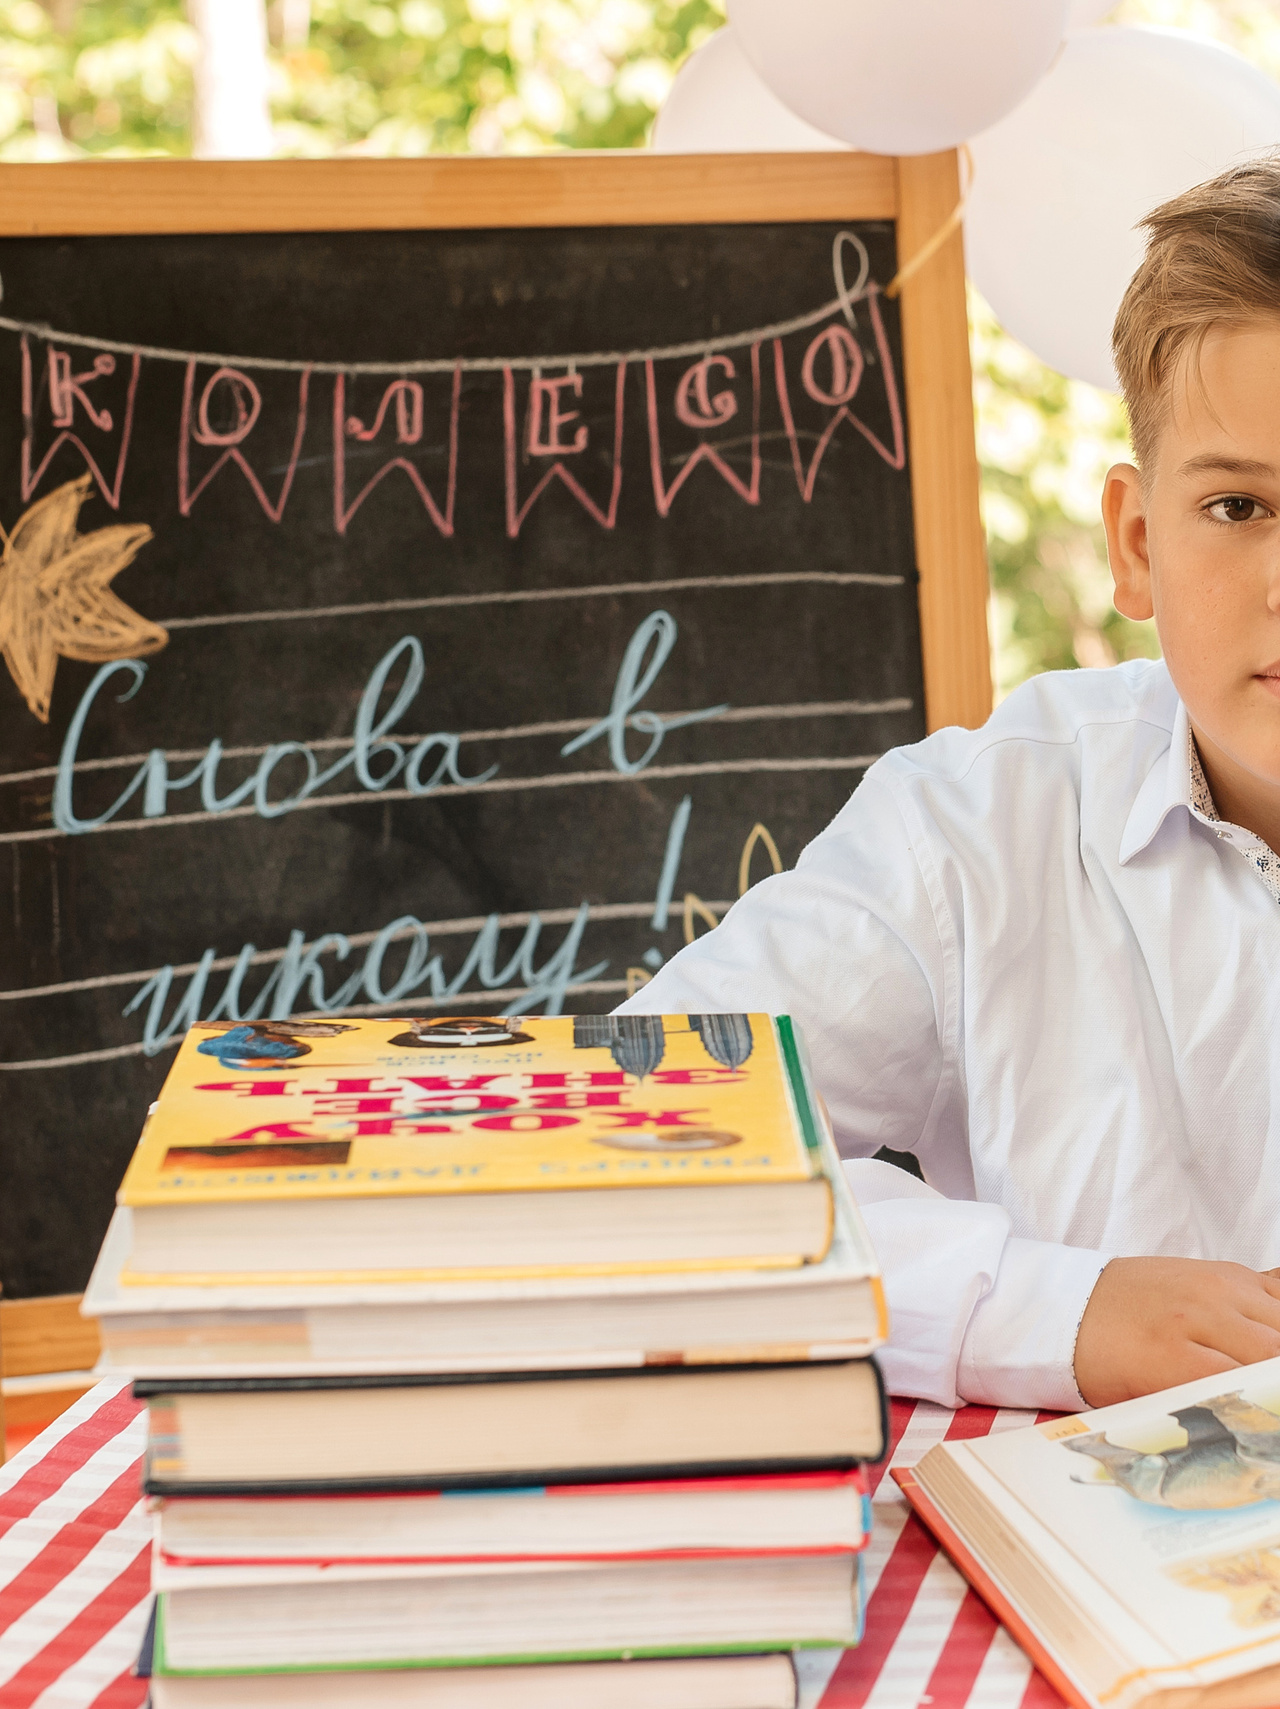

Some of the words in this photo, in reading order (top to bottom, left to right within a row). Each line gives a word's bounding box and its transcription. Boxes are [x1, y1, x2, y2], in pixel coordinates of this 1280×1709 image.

[52, 634, 499, 834] Снова
[560, 609, 731, 775] в
[192, 1068, 751, 1097] ЗНАТЬ
[311, 1090, 634, 1115] ВСЕ
[211, 1108, 713, 1143] ХОЧУ
